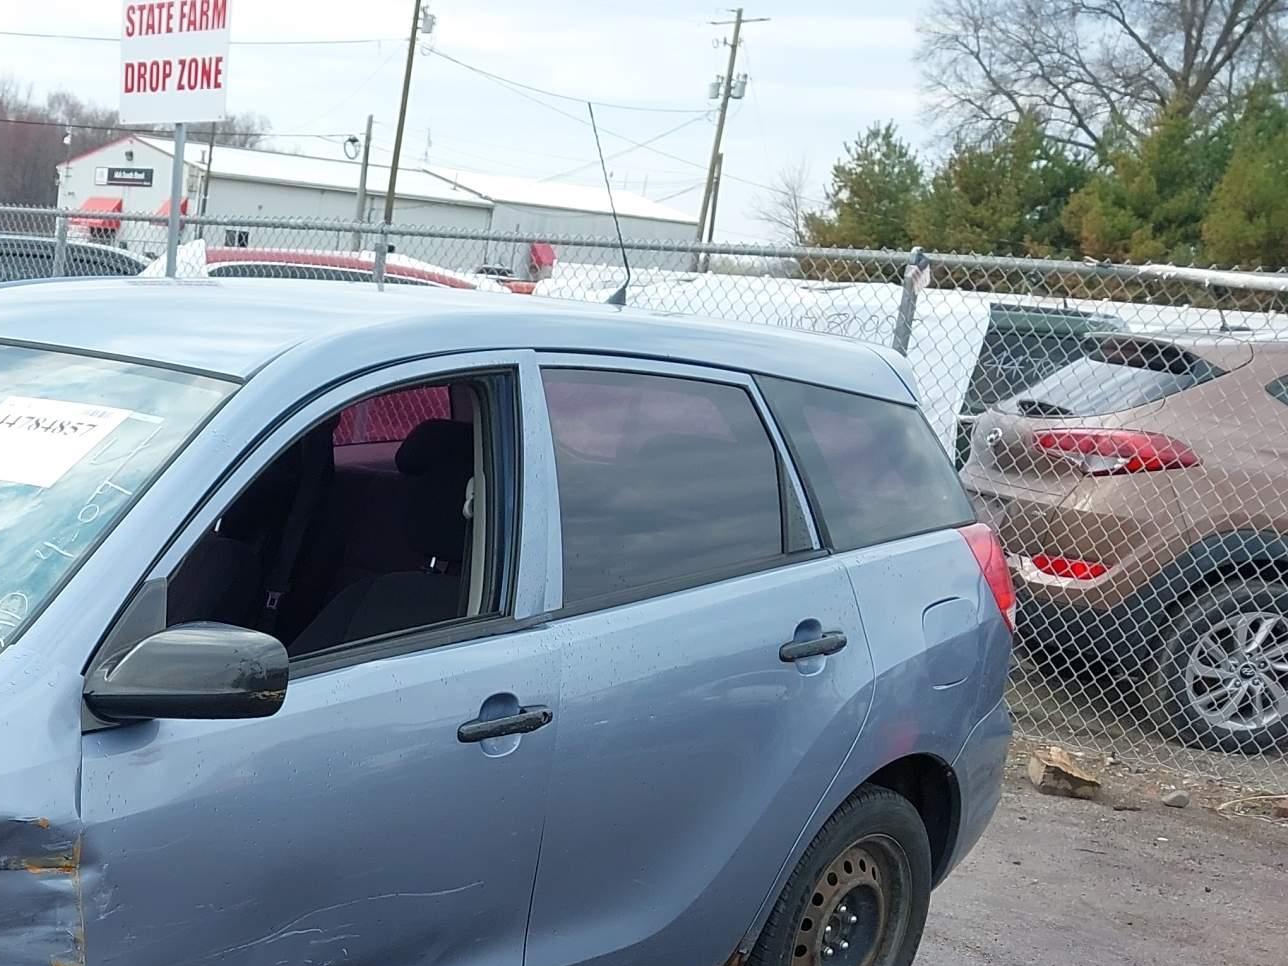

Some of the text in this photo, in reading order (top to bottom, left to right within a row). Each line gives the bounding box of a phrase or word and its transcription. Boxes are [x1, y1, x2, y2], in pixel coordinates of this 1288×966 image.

[126, 0, 227, 37] STATE FARM
[124, 56, 223, 93] DROP ZONE
